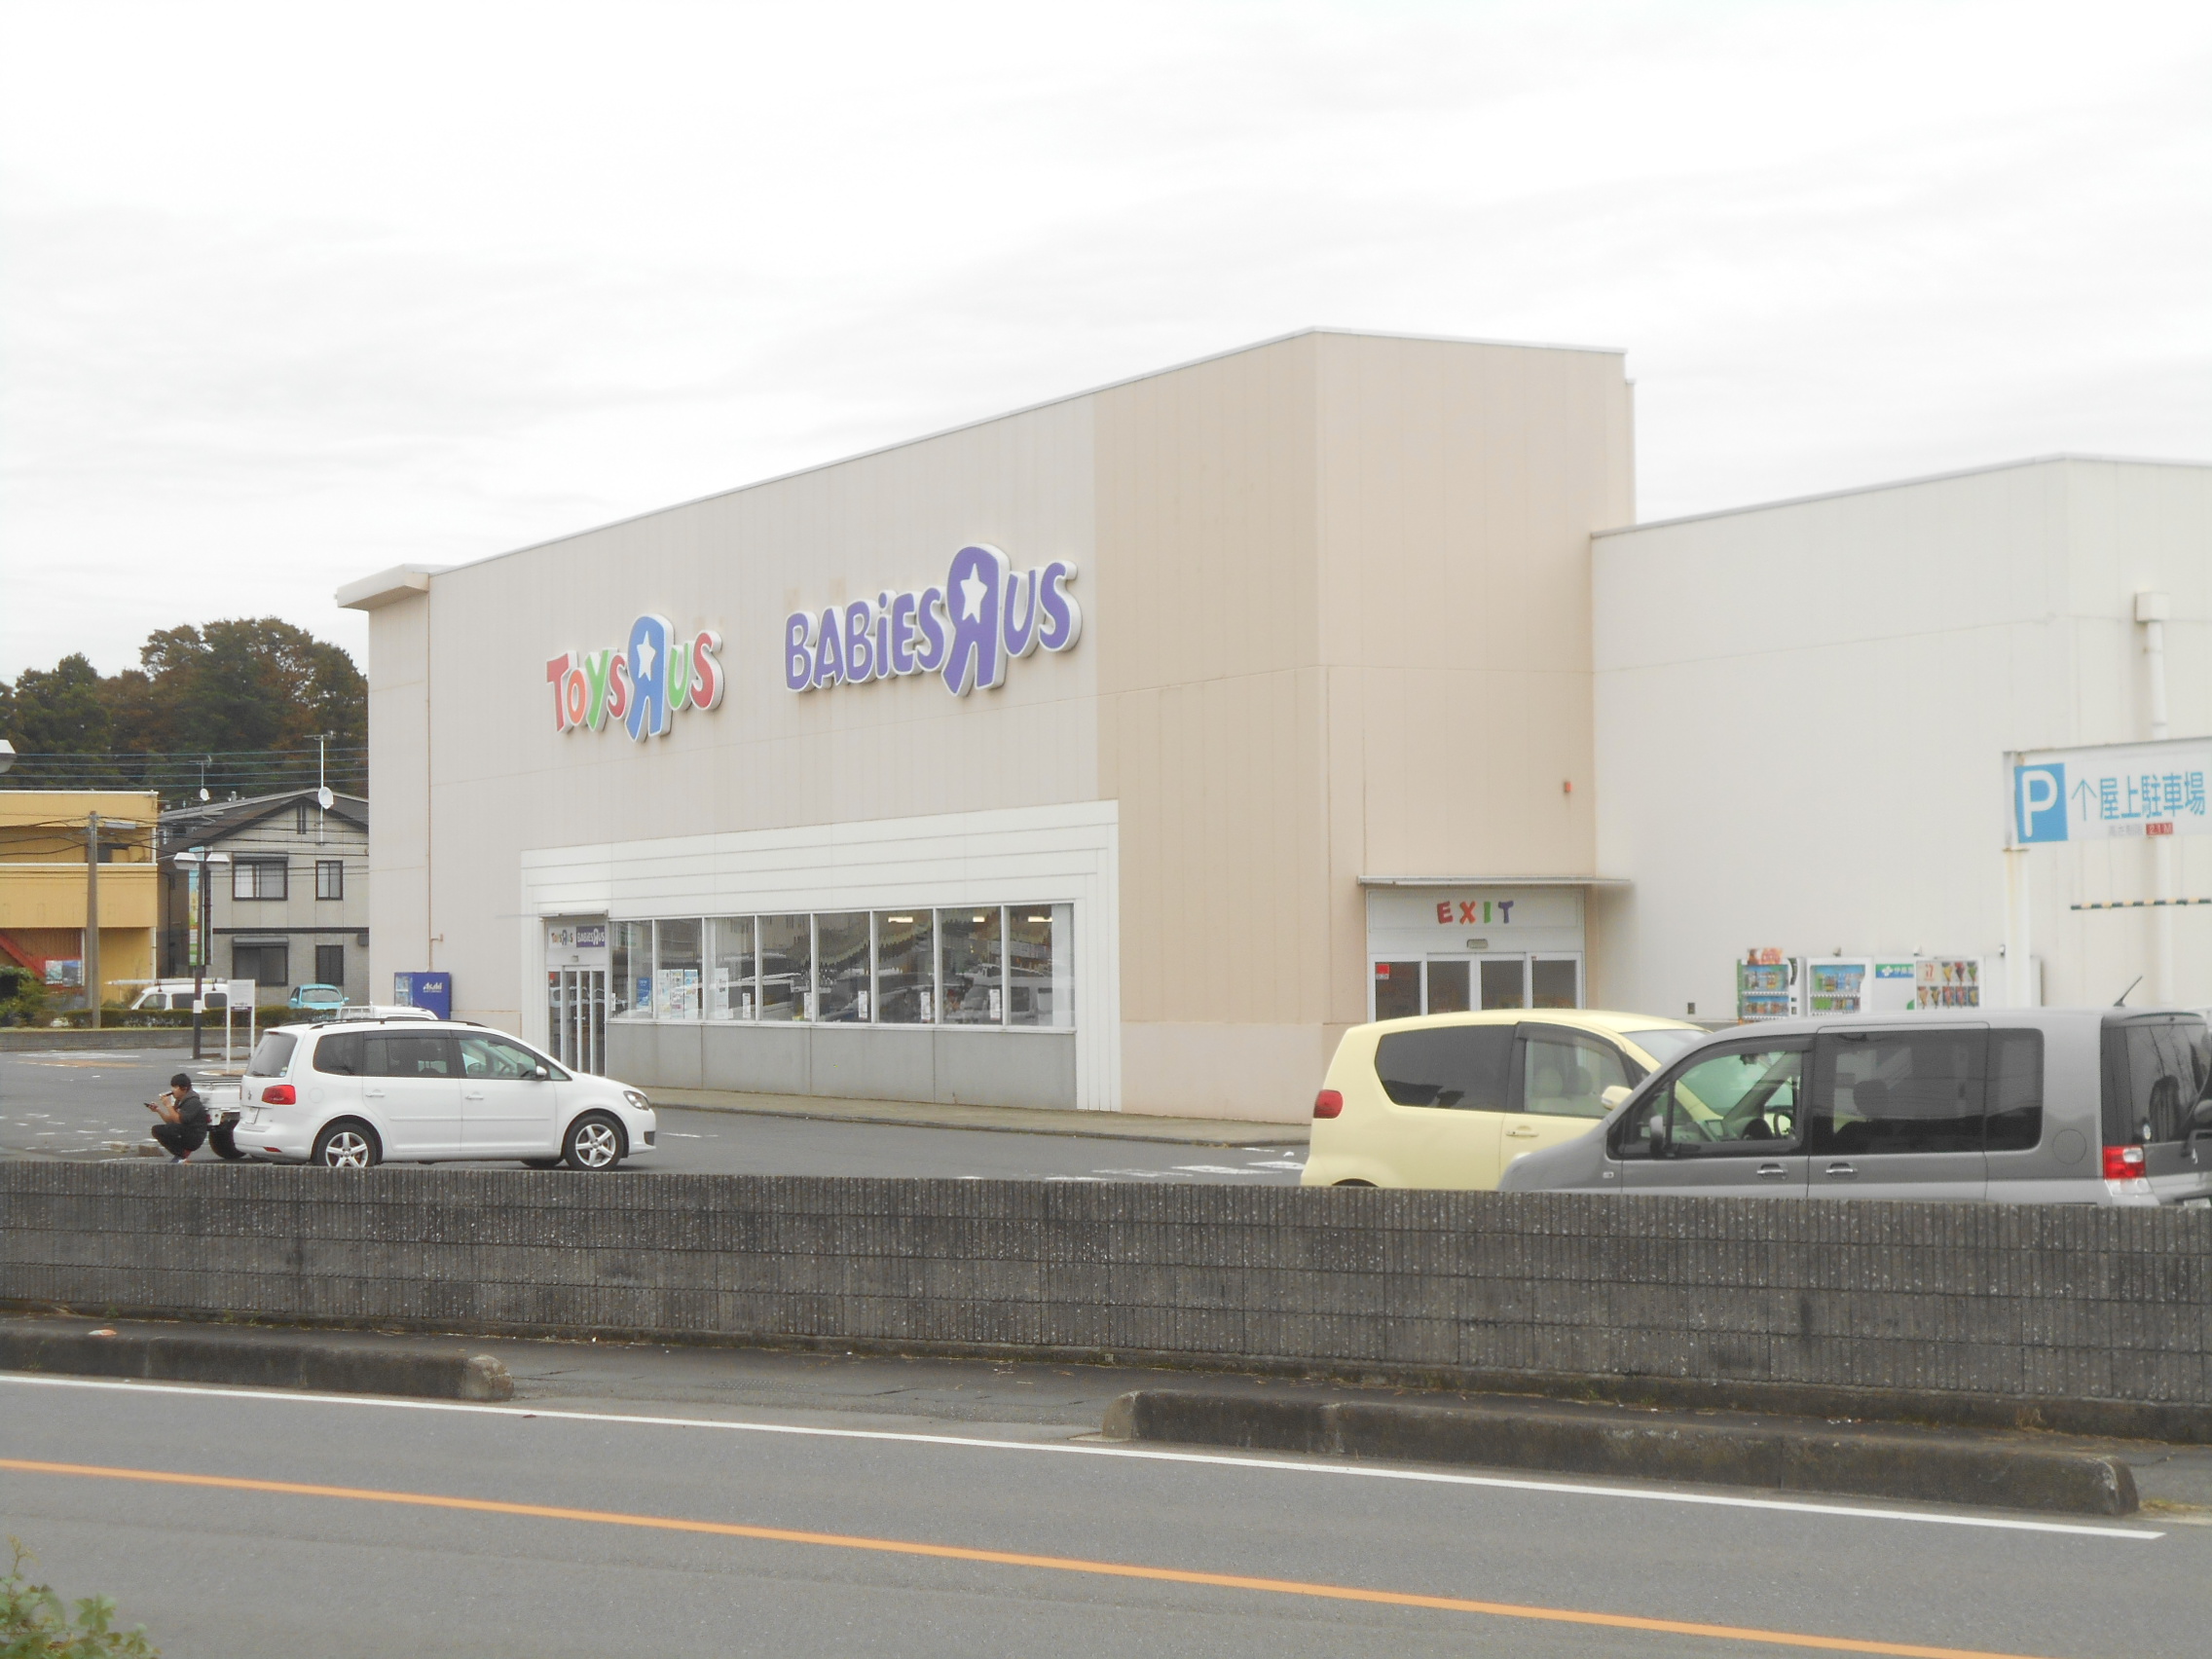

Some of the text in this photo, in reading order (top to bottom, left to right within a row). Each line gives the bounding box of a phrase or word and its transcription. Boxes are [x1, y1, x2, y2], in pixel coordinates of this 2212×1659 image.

[2022, 770, 2058, 837] P
[2100, 771, 2206, 820] 屋上駐車場
[1436, 900, 1514, 924] EXIT
